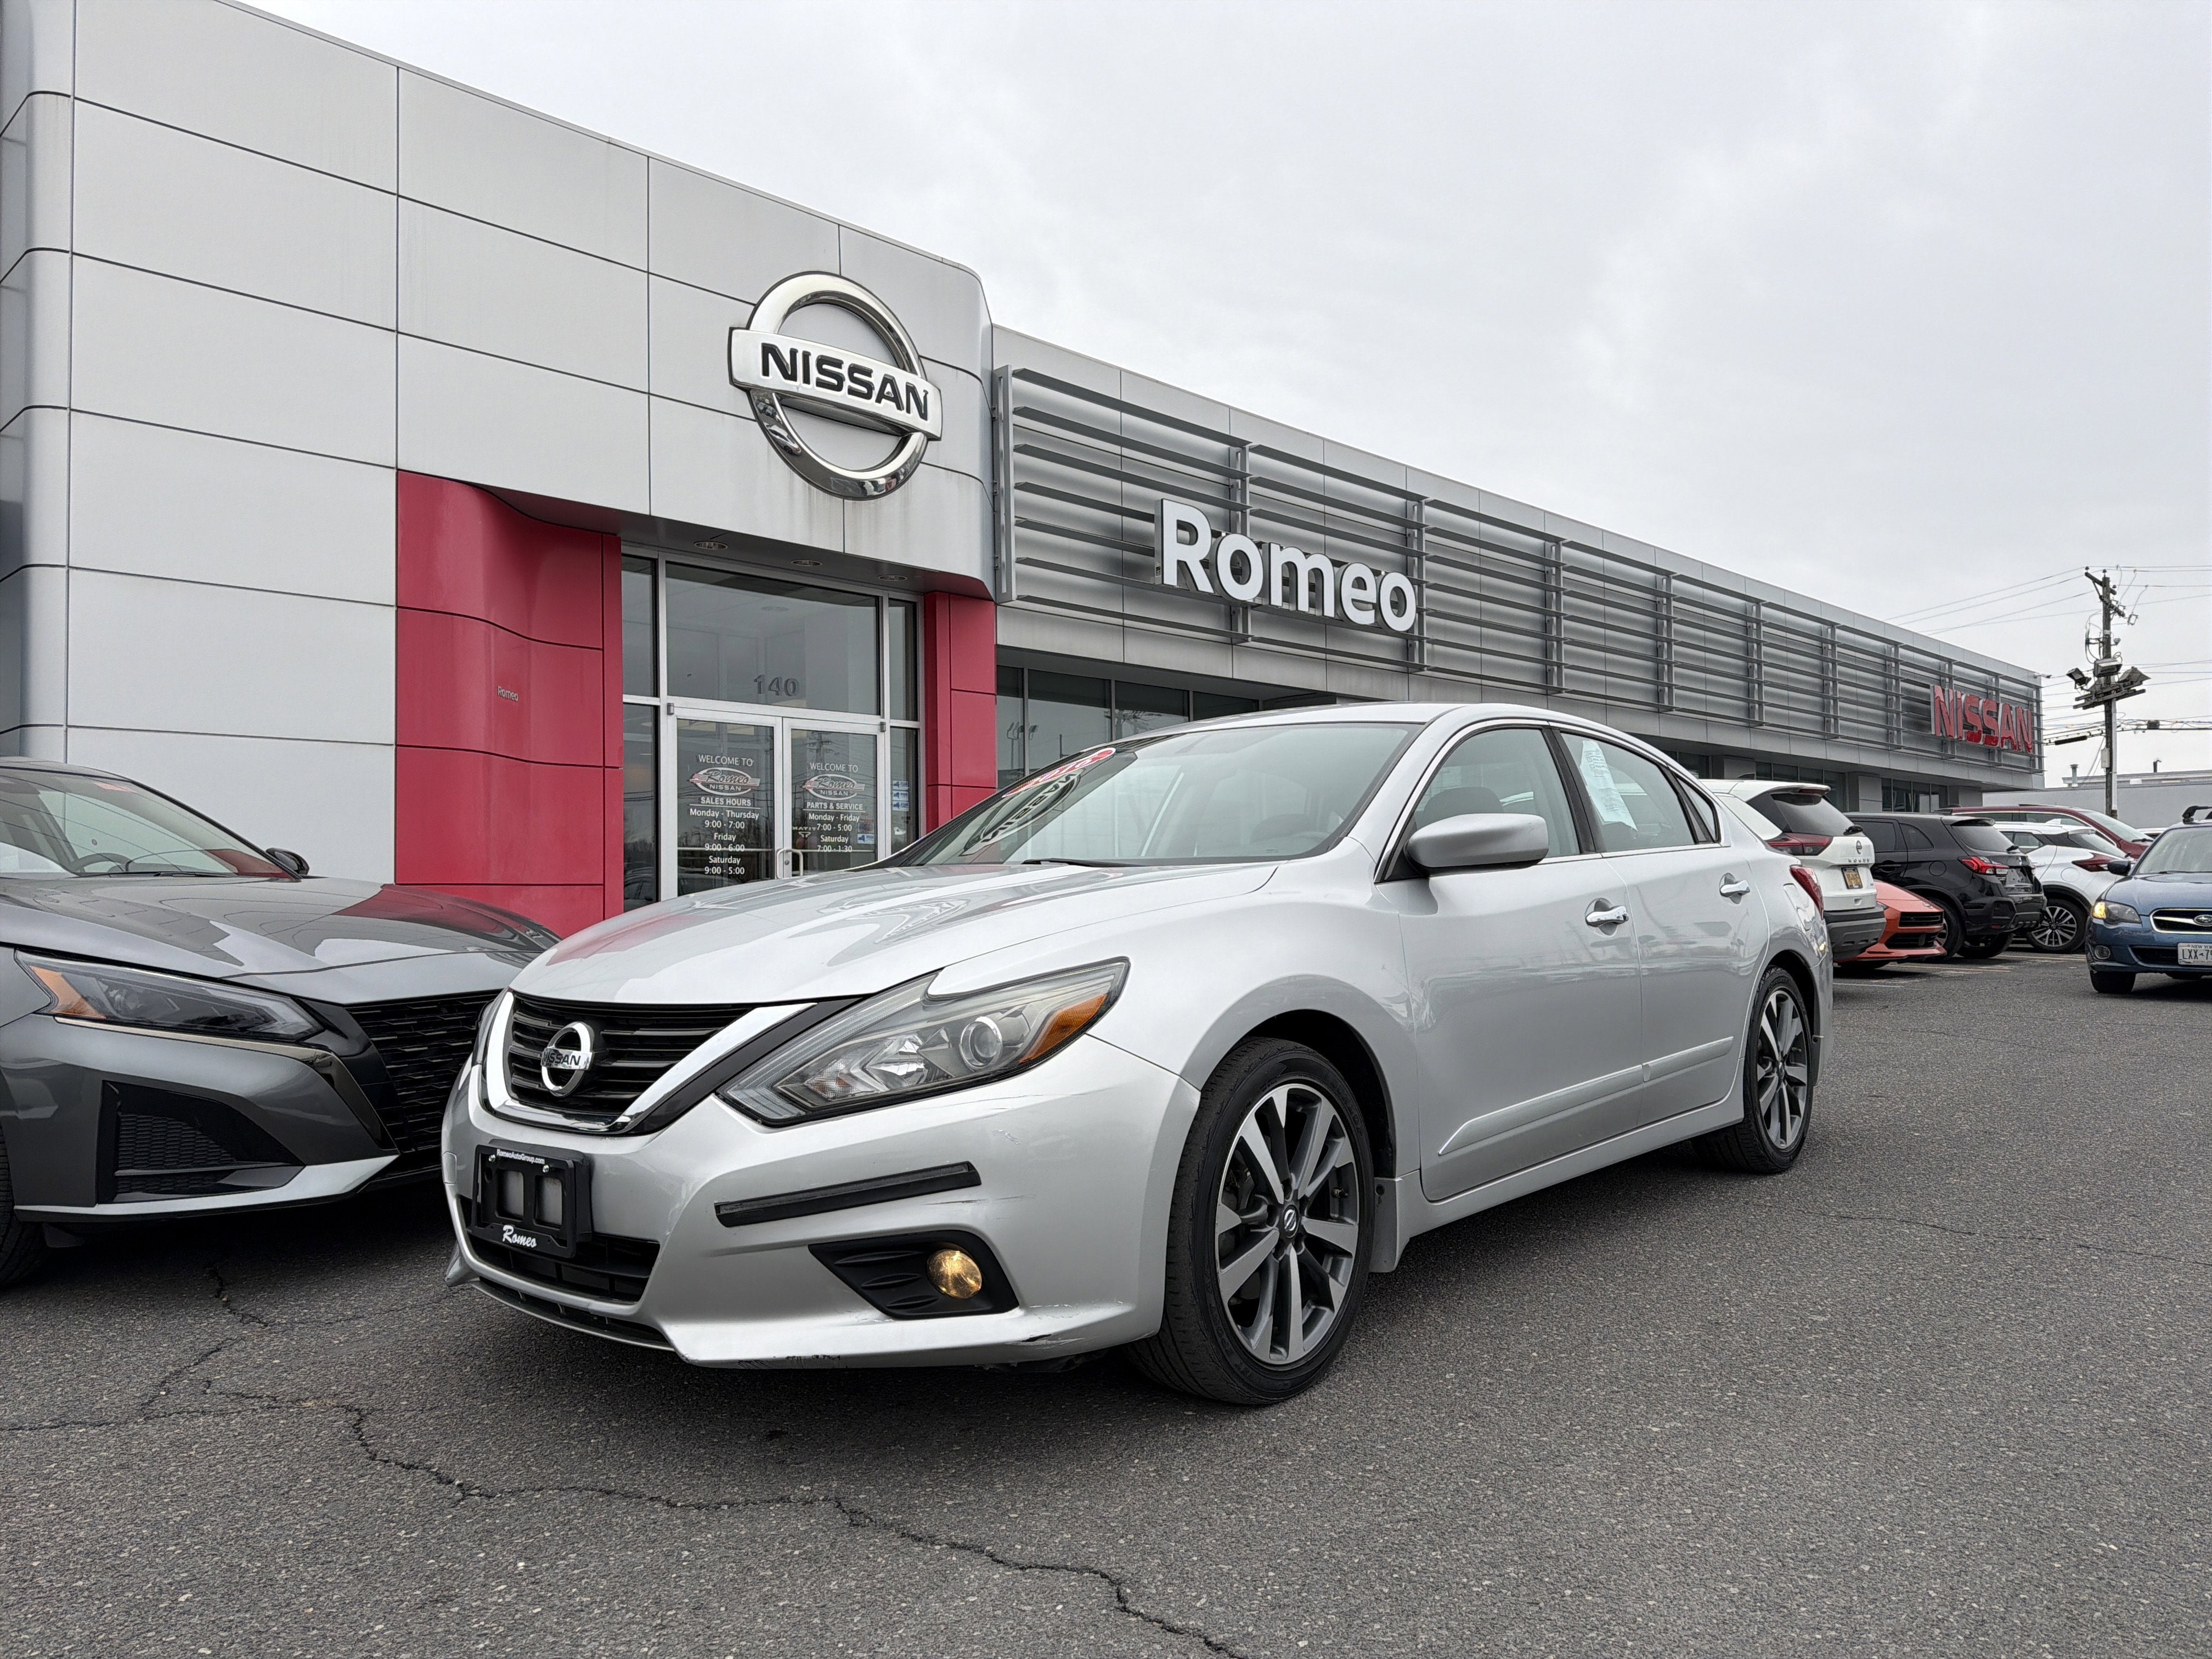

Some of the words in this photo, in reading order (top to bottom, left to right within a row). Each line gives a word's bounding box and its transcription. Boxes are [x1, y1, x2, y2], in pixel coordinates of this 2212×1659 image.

[761, 342, 928, 421] NISSAN
[1155, 498, 1417, 633] Romeo
[754, 674, 799, 696] 140
[497, 685, 519, 702] Romeo
[1932, 684, 2033, 754] NISSAN
[698, 754, 739, 766] WELCOME
[741, 758, 753, 767] TO
[810, 762, 846, 772] WELCOME
[848, 764, 859, 772] TO
[703, 769, 749, 785] Romeo
[815, 775, 856, 789] Romeo
[701, 797, 724, 805] SALES
[690, 808, 720, 819] Monday
[726, 810, 759, 821] Thursday
[809, 812, 834, 822] Monday
[840, 814, 860, 822] Friday
[704, 820, 721, 828] 9:00
[729, 821, 745, 829] 7:00
[816, 823, 832, 831] 7:00
[714, 832, 736, 842] Friday
[820, 834, 849, 844] Saturday
[704, 843, 722, 851] 9:00
[728, 844, 745, 852] 6:00
[709, 855, 741, 865] Saturday
[544, 1051, 582, 1066] NISSAN
[496, 1148, 545, 1164] RomeoAutoGroup.com
[502, 1224, 537, 1248] Romeo
